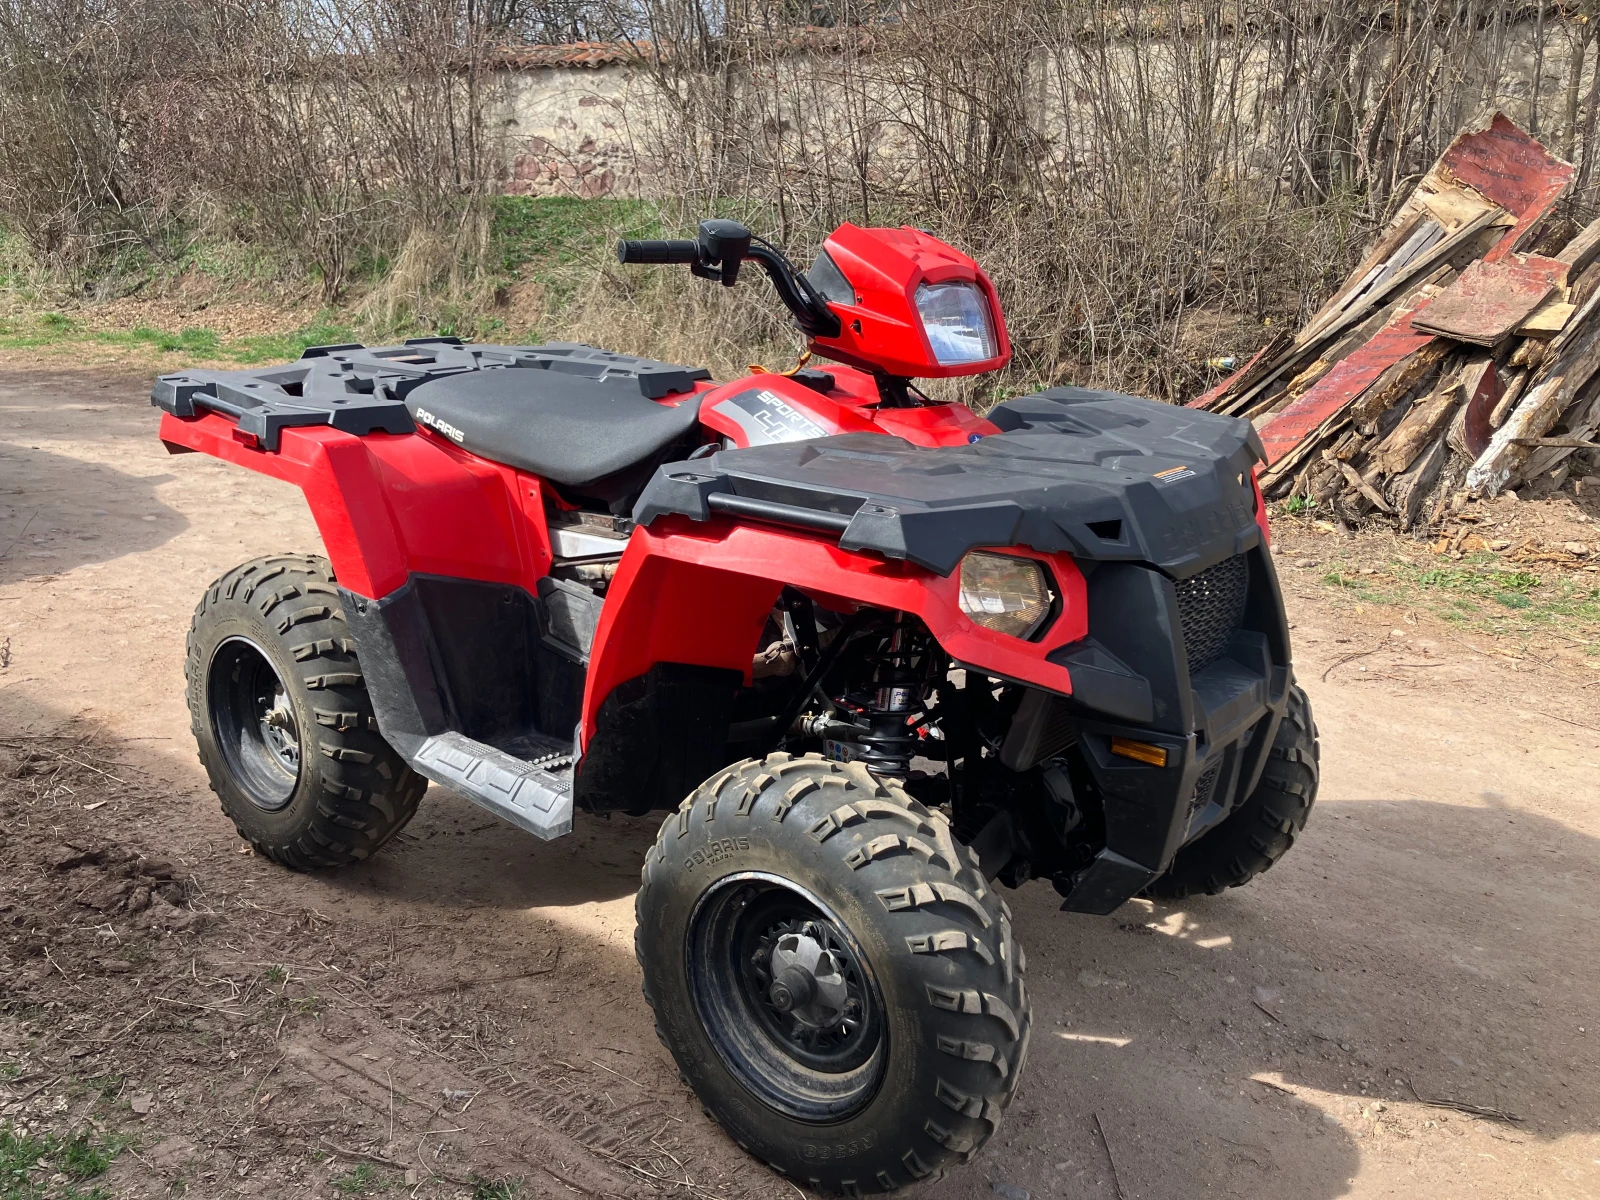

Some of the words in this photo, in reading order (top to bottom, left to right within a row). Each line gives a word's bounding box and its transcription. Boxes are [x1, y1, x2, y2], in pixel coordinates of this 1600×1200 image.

[416, 407, 465, 443] POLARIS
[757, 390, 830, 438] SPORTS
[684, 837, 751, 873] POLARIS
